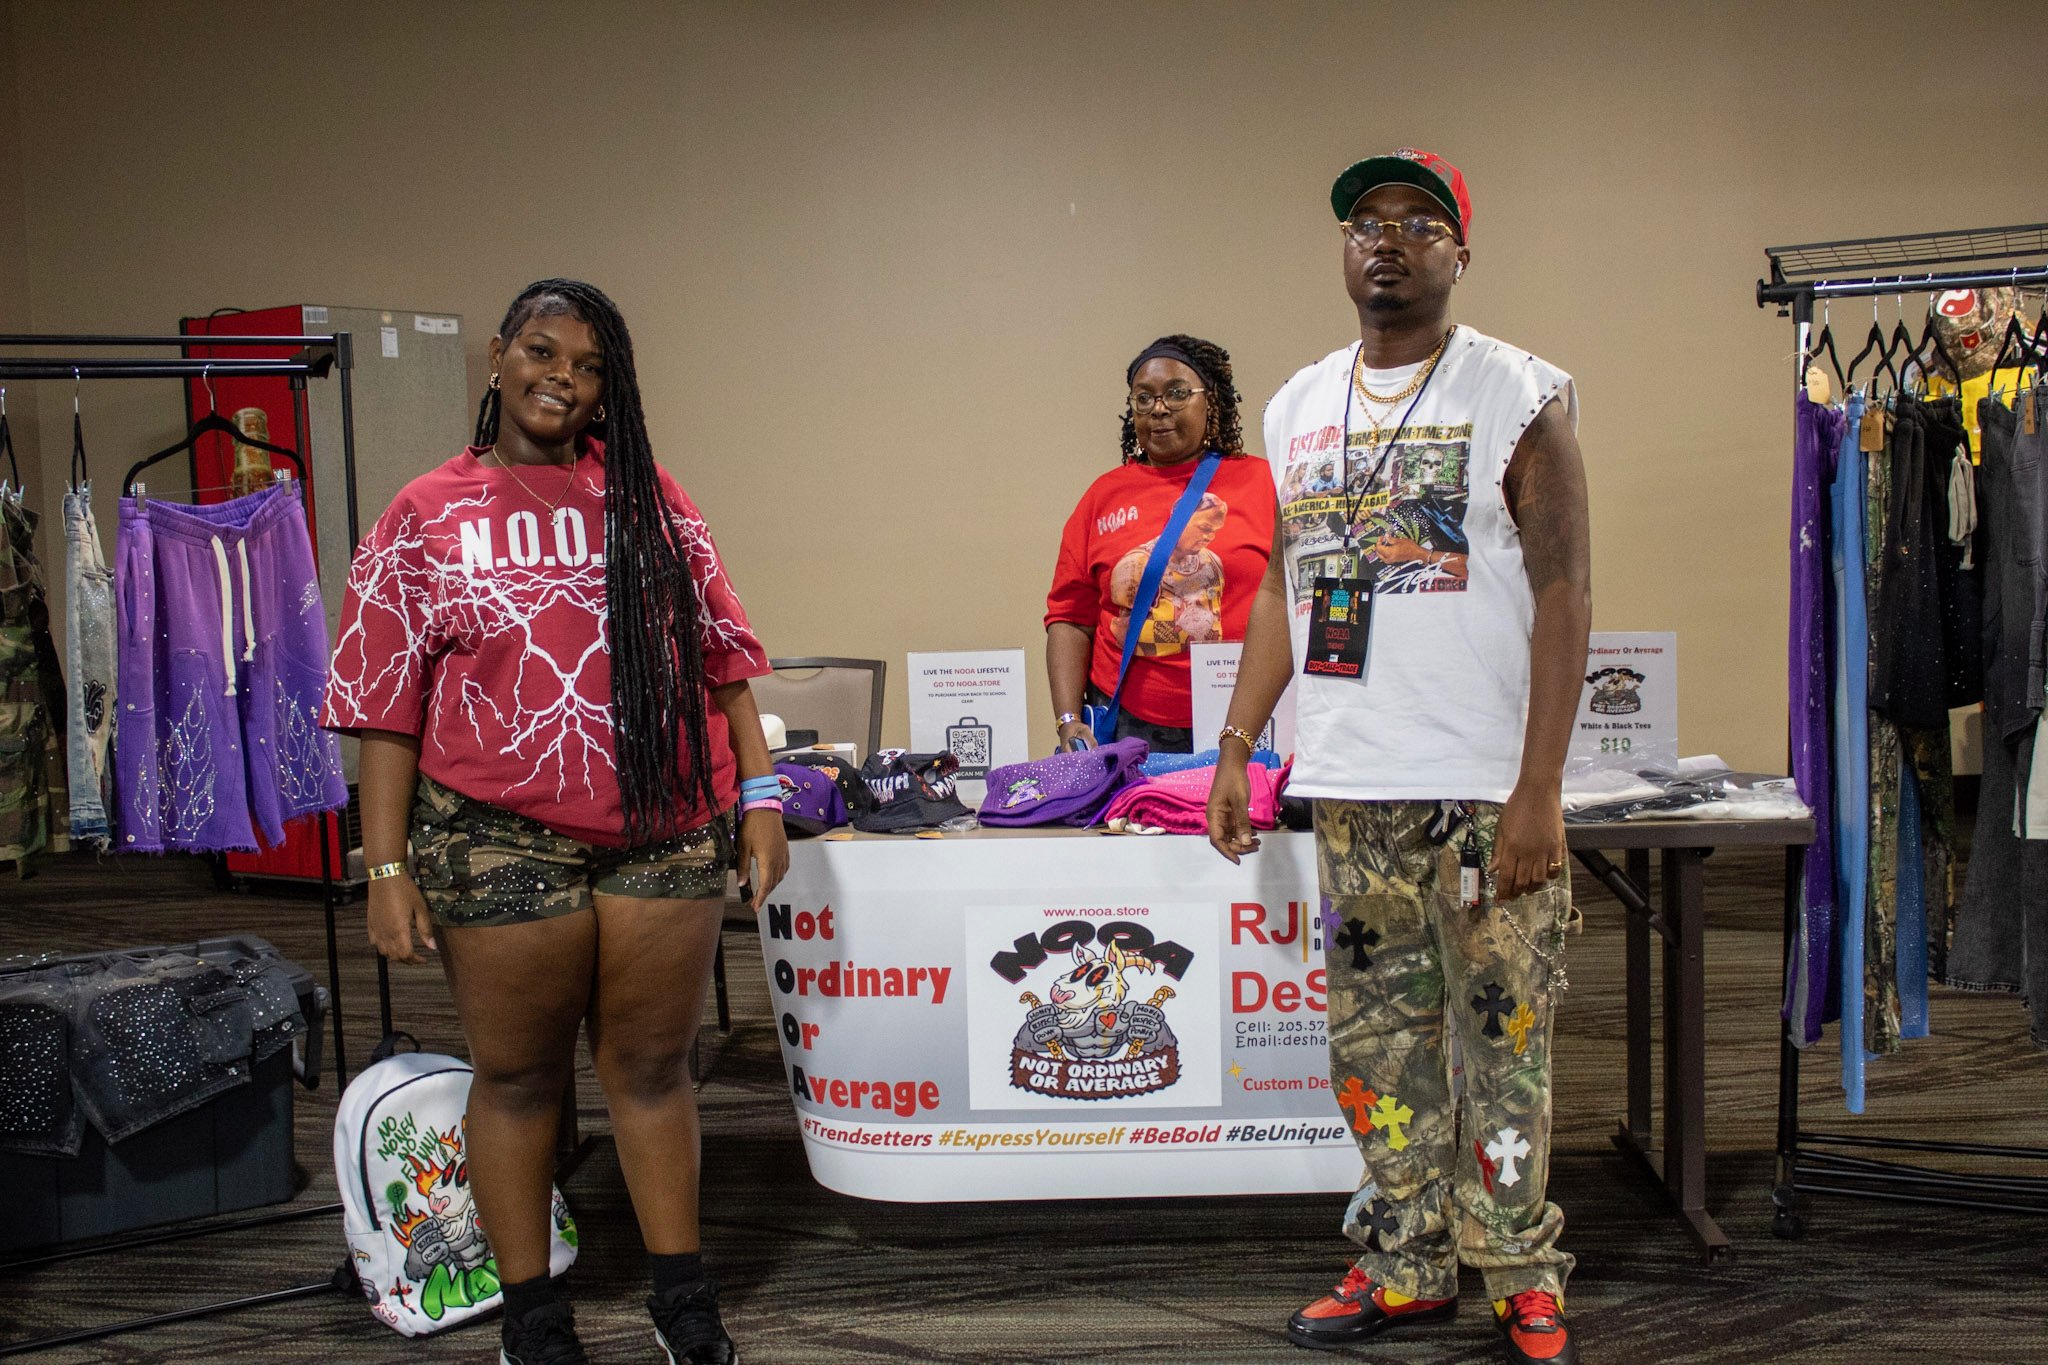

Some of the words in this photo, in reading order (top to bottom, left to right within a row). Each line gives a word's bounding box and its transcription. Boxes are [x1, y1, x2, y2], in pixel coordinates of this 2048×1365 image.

[1634, 646, 1663, 654] Average
[1612, 722, 1633, 730] Black
[1634, 722, 1651, 730] Tees
[1600, 737, 1631, 753] $10
[768, 904, 834, 941] Not
[1043, 906, 1150, 917] www.nooa.store
[1231, 901, 1298, 946] RJ
[775, 958, 952, 1004] Ordinary
[782, 1012, 820, 1050] Or
[1235, 1020, 1271, 1034] Cell:
[1277, 1020, 1328, 1032] 205.57
[1019, 1056, 1063, 1075] NOT
[1067, 1054, 1169, 1078] ORDINARY
[792, 1063, 940, 1118] Average
[1029, 1073, 1059, 1089] OR
[1065, 1072, 1162, 1092] AVERAGE
[1243, 1076, 1303, 1091] Custom
[377, 1115, 397, 1142] NO
[377, 1110, 418, 1162] MONEY
[804, 1117, 933, 1147] #Trendsetters
[938, 1126, 1127, 1152] #ExpressYourself
[1129, 1125, 1222, 1145] #BeBold
[1226, 1122, 1345, 1145] #BeUnique
